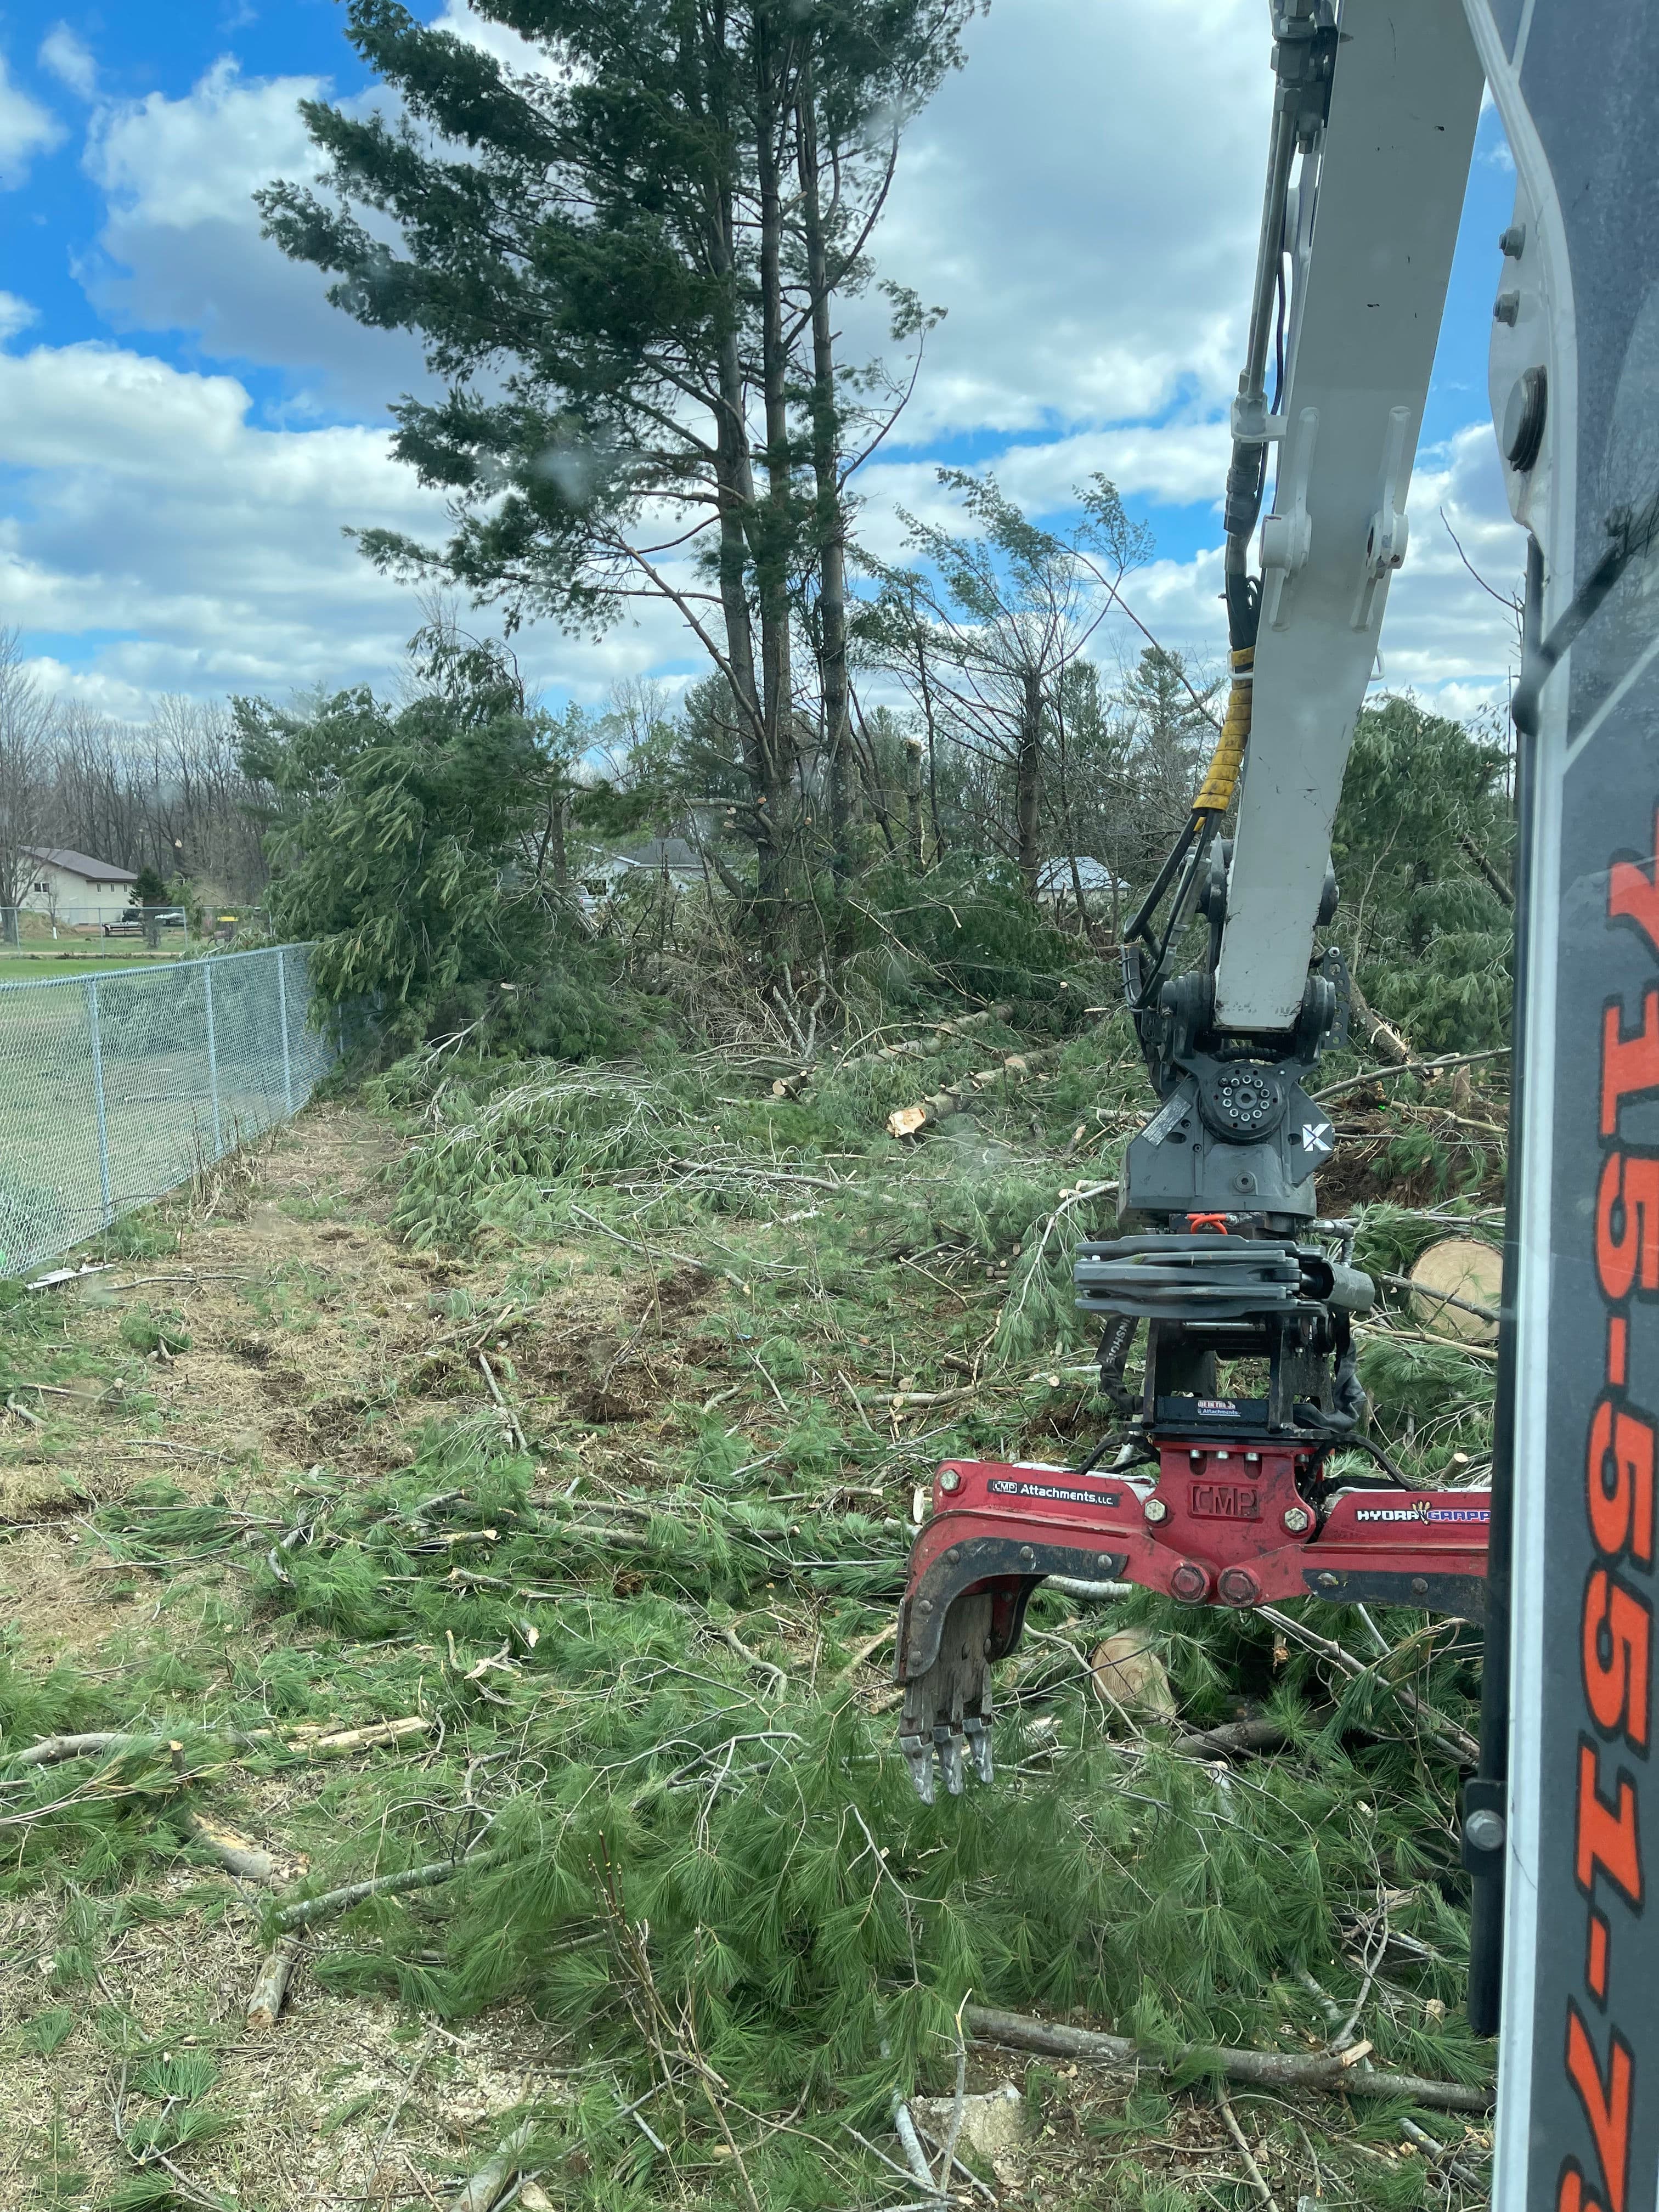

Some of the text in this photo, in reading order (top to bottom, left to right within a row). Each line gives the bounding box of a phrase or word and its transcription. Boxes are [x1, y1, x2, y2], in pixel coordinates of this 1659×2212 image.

[1195, 1485, 1256, 1519] CMP
[1357, 1510, 1419, 1520] HYDRA
[1556, 795, 1659, 2212] 715-551-7
